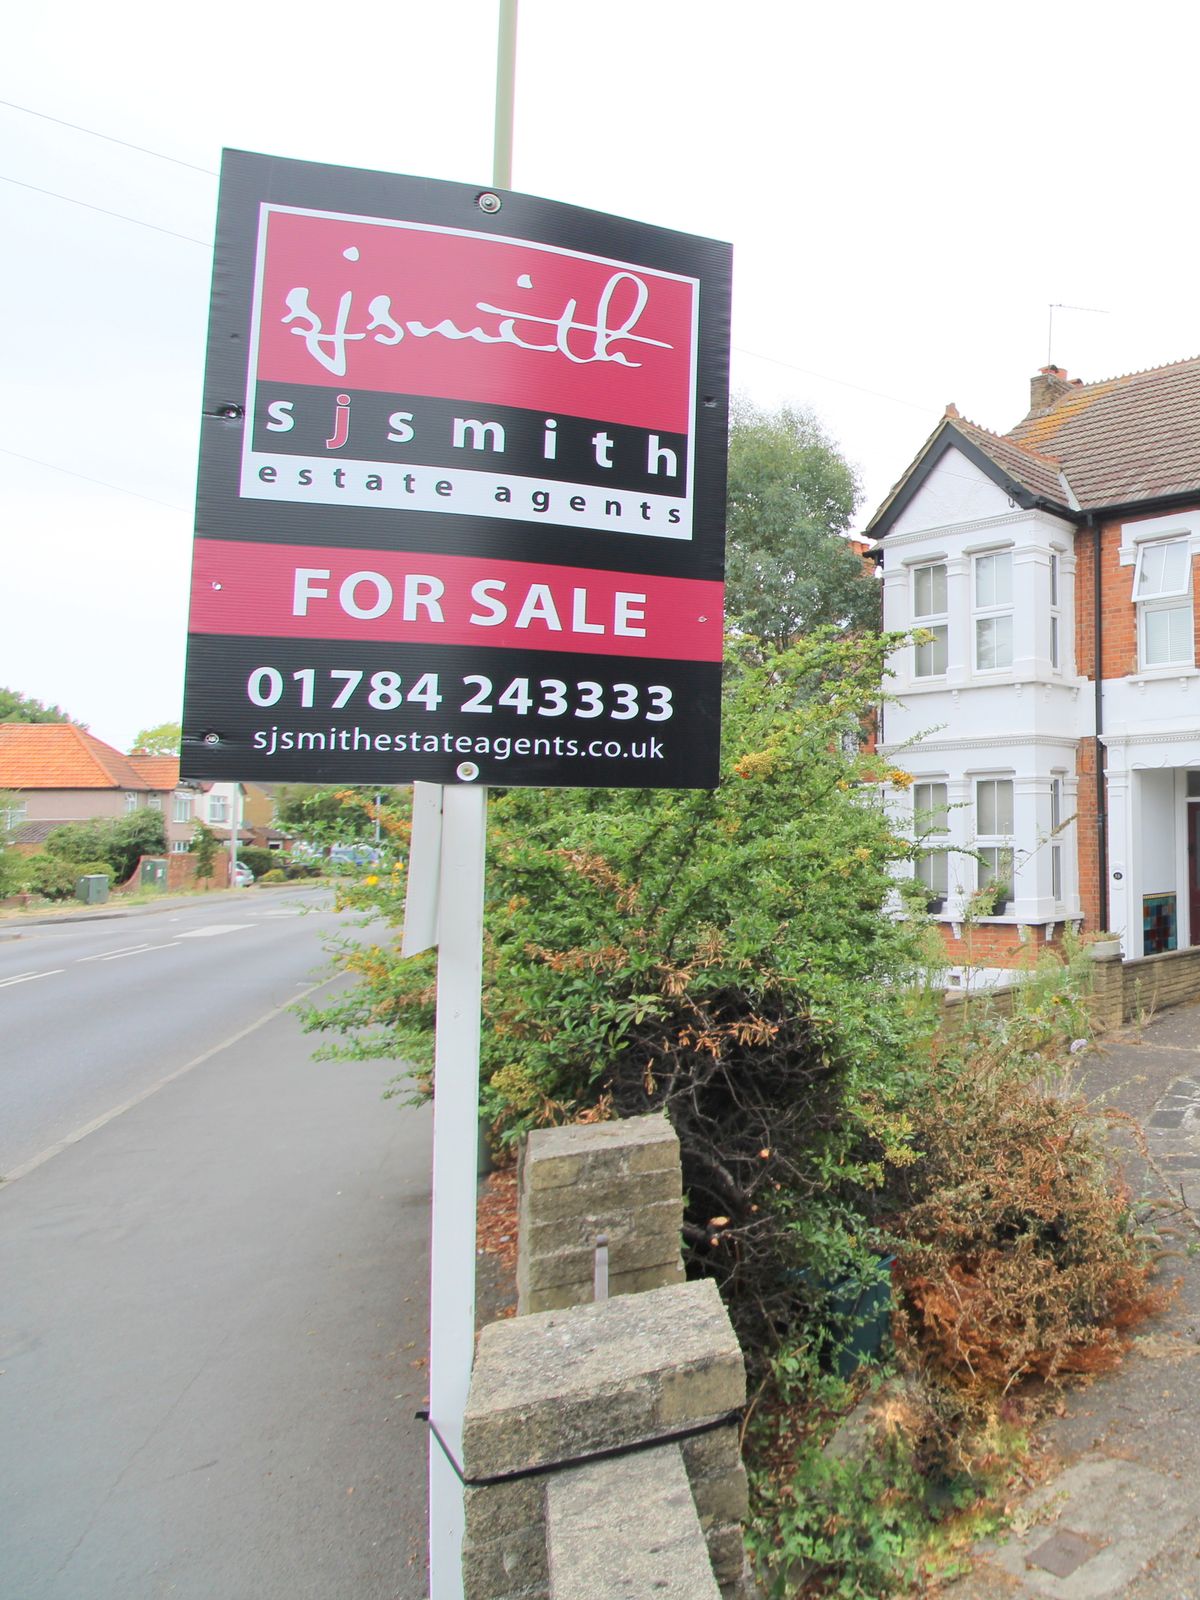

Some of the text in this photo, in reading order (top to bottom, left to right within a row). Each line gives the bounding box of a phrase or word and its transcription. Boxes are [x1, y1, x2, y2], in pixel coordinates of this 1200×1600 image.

[259, 462, 682, 524] estate agents
[292, 567, 647, 638] FOR SALE
[247, 666, 673, 722] 01784 243333
[253, 726, 664, 760] sjsmithestateagents.co.uk
